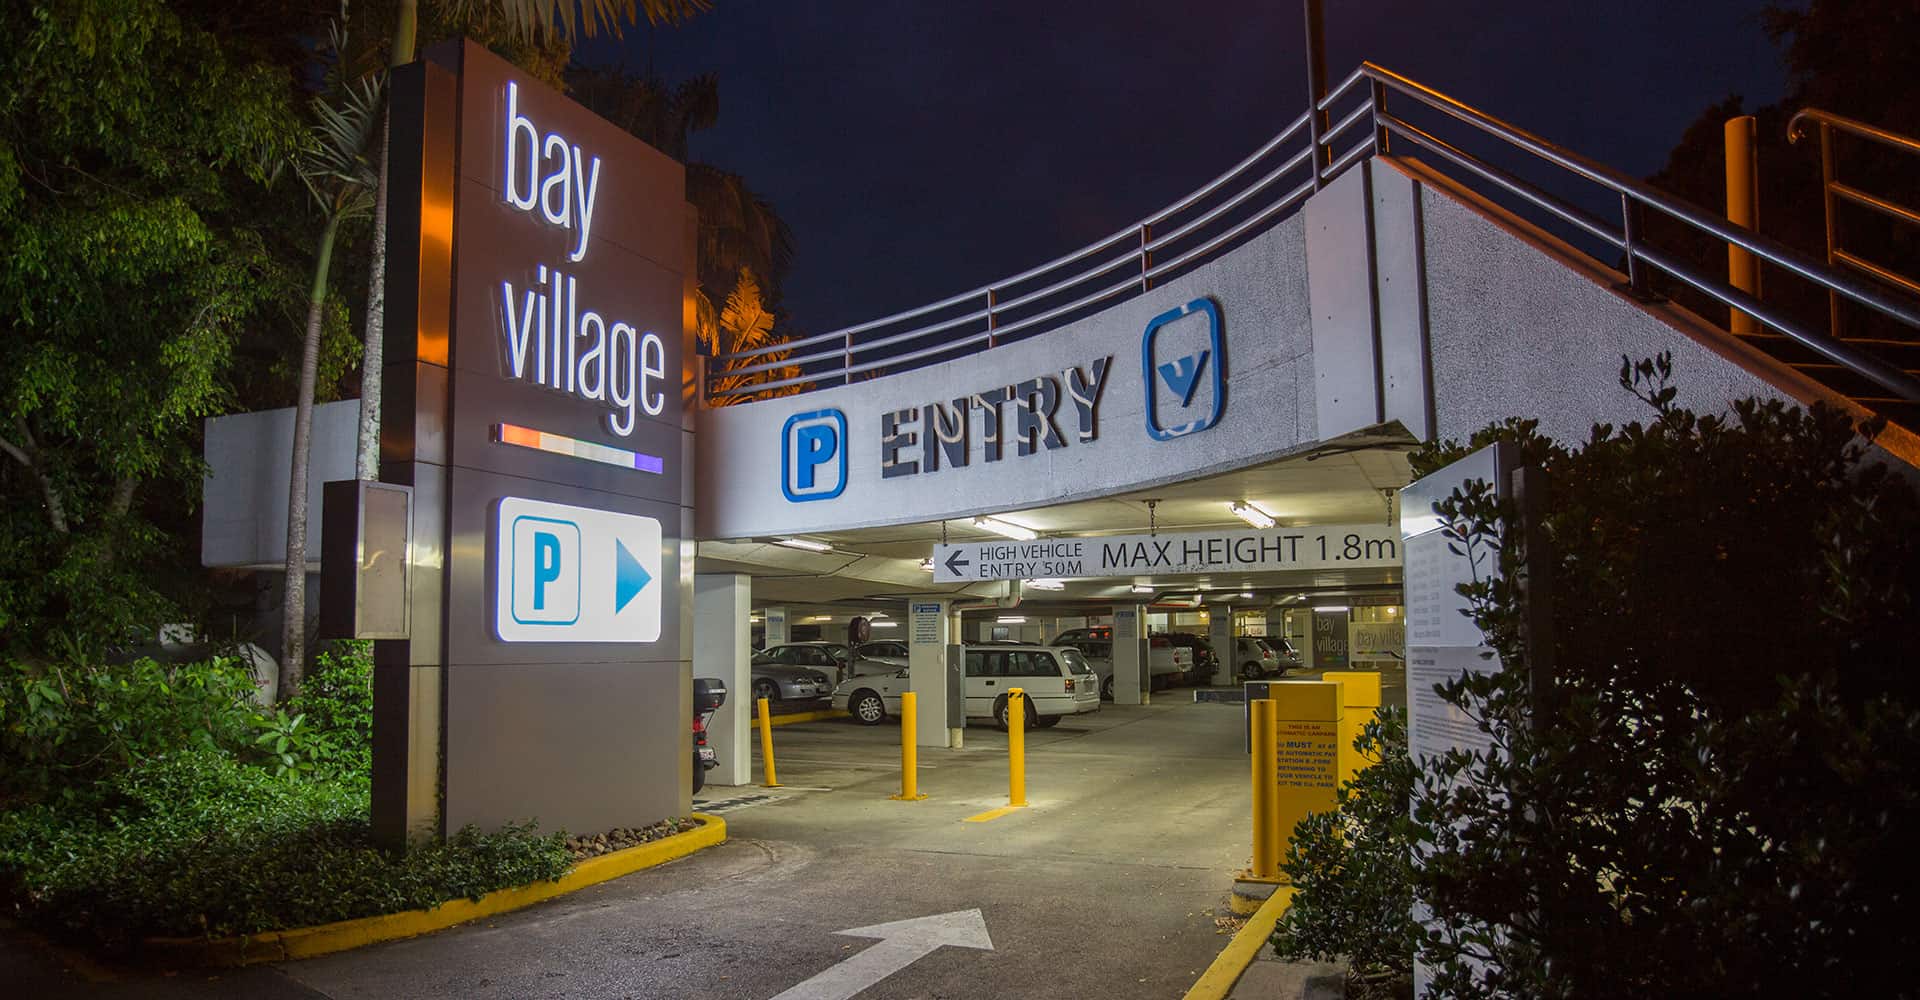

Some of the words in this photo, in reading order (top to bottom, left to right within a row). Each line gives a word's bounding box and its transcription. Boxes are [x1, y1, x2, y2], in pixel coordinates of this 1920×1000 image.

[505, 81, 600, 262] bay
[504, 265, 665, 437] village
[797, 425, 837, 490] P
[882, 355, 1112, 479] ENTRY
[980, 546, 1017, 561] HIGH
[1020, 543, 1083, 559] VEHICLE
[980, 562, 1036, 578] ENTRY
[1043, 560, 1083, 576] 50M
[1102, 540, 1172, 569] MAX
[1183, 535, 1304, 565] HEIGHT
[1316, 534, 1396, 561] 1.8m
[533, 531, 561, 611] P
[1316, 616, 1335, 634] bay
[1286, 741, 1312, 749] MUST
